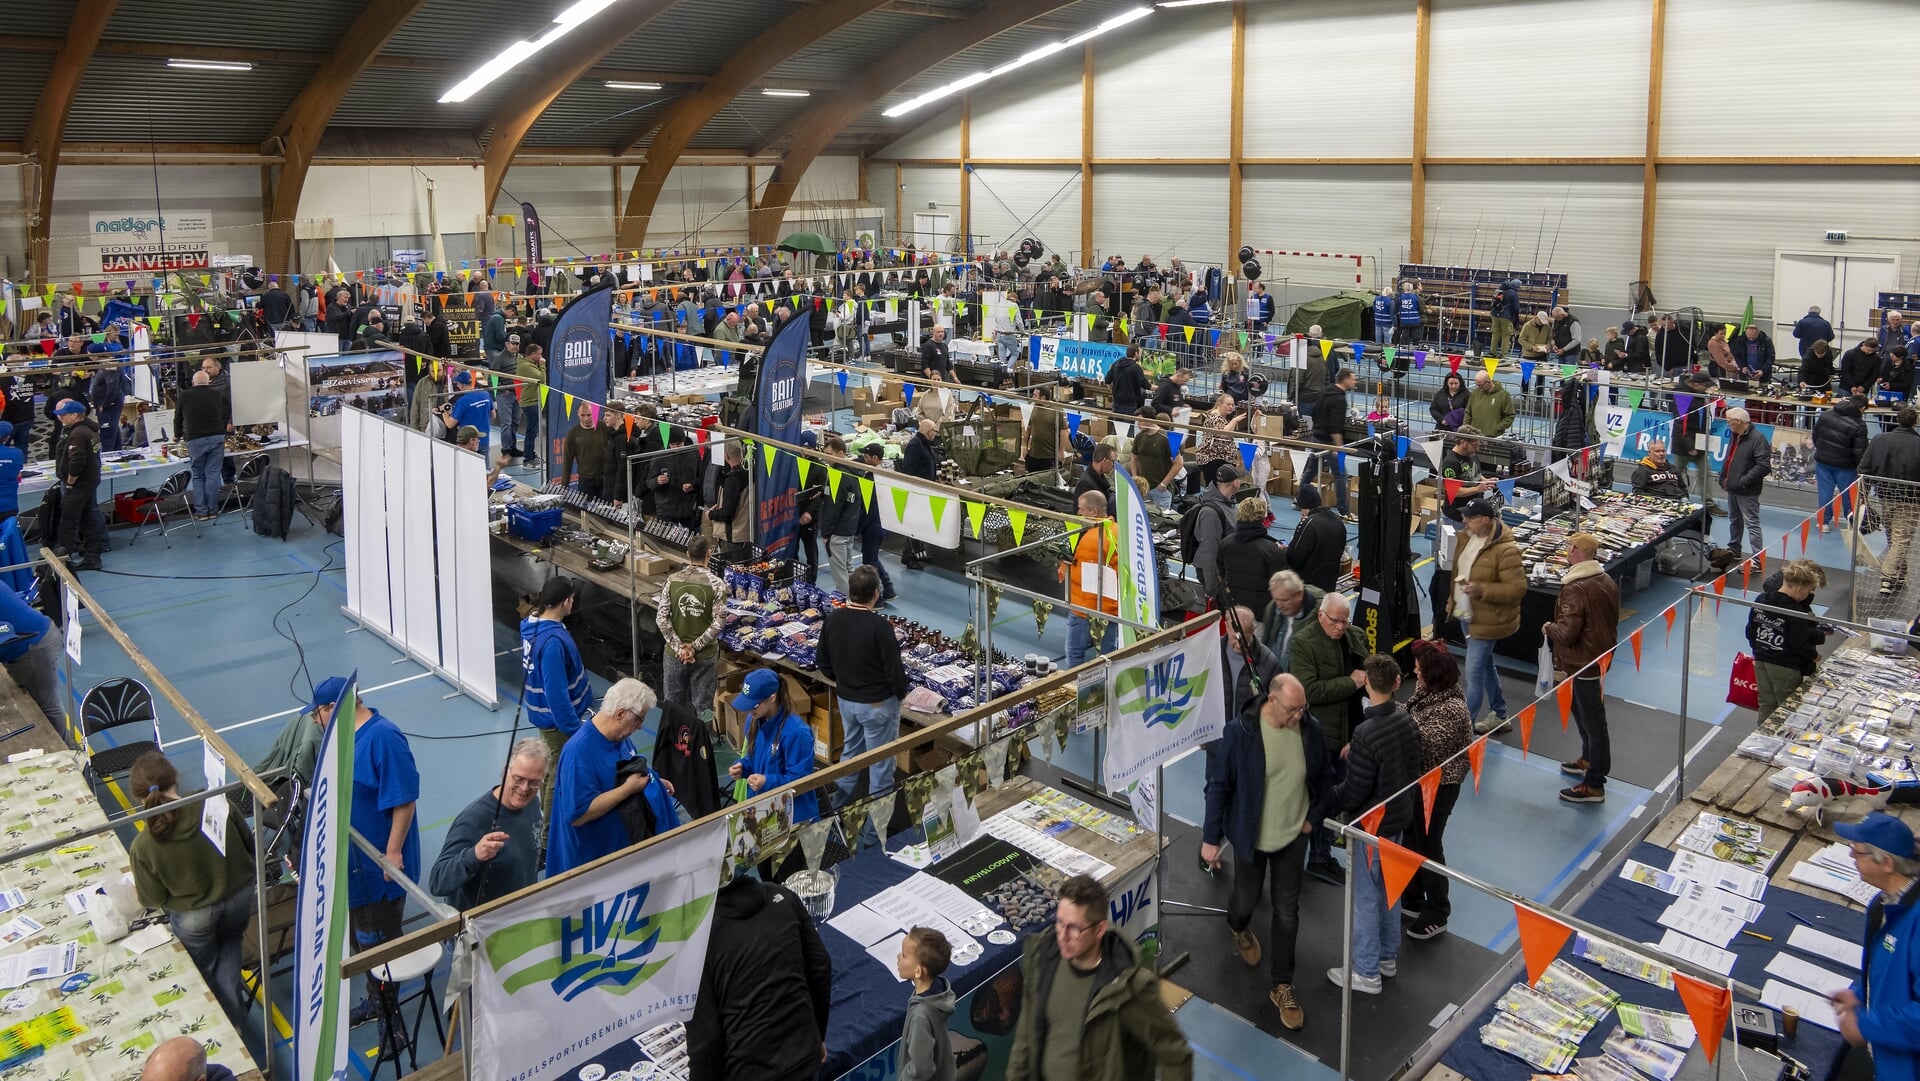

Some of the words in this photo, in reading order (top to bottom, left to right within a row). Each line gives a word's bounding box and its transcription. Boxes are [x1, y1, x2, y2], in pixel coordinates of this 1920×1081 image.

[101, 243, 209, 254] BOUWBEDRIJF
[104, 255, 140, 271] JAN
[143, 253, 181, 269] VET
[183, 252, 207, 267] BV
[565, 340, 593, 360] BAIT
[1042, 343, 1055, 353] HVZ
[1064, 345, 1111, 357] WEDSRIJDVISSEN
[564, 356, 593, 367] SOLUTIONS
[1062, 355, 1103, 375] BAARS
[772, 377, 795, 403] BAIT
[771, 397, 793, 412] SOLUTIONS
[1606, 413, 1623, 427] VZ
[1145, 652, 1188, 702] HVZ
[1112, 741, 1180, 780] HENGELSPORTVERENIGING
[313, 776, 328, 960] WEDSTRIJD
[1110, 873, 1152, 929] HVZ
[561, 880, 650, 965] HVZ
[310, 962, 323, 1027] VIS
[506, 1009, 642, 1081] NGELSPORTVERENIGING
[647, 993, 698, 1014] ZAANSTR
